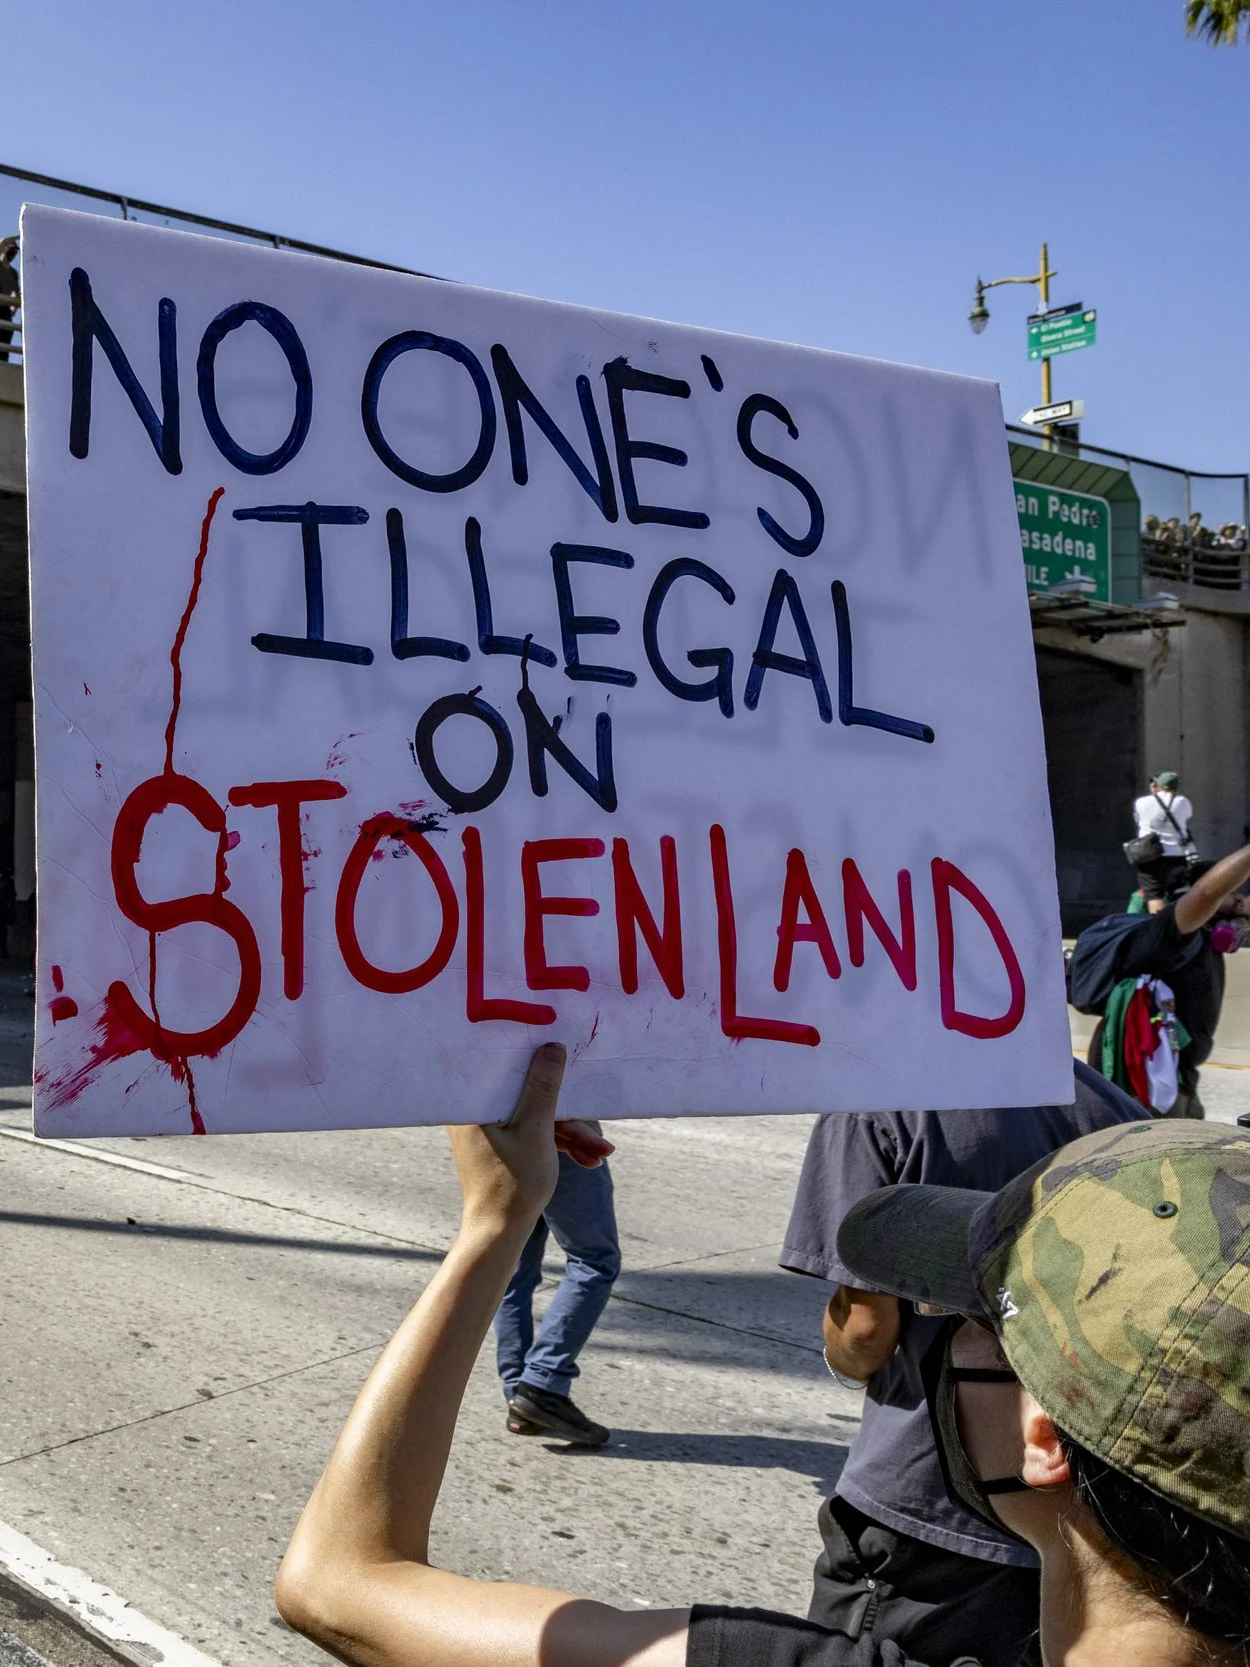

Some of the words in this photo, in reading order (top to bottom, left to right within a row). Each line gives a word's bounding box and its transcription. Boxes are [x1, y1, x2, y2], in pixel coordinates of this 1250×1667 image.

[70, 267, 313, 475] NO
[361, 330, 825, 557] ONE'S
[1016, 494, 1039, 516] an
[233, 501, 935, 743] ILLEGAL
[1021, 529, 1096, 560] asadena
[412, 680, 618, 812] ON
[111, 772, 685, 1057] STOLEN
[709, 824, 1026, 1047] LAND
